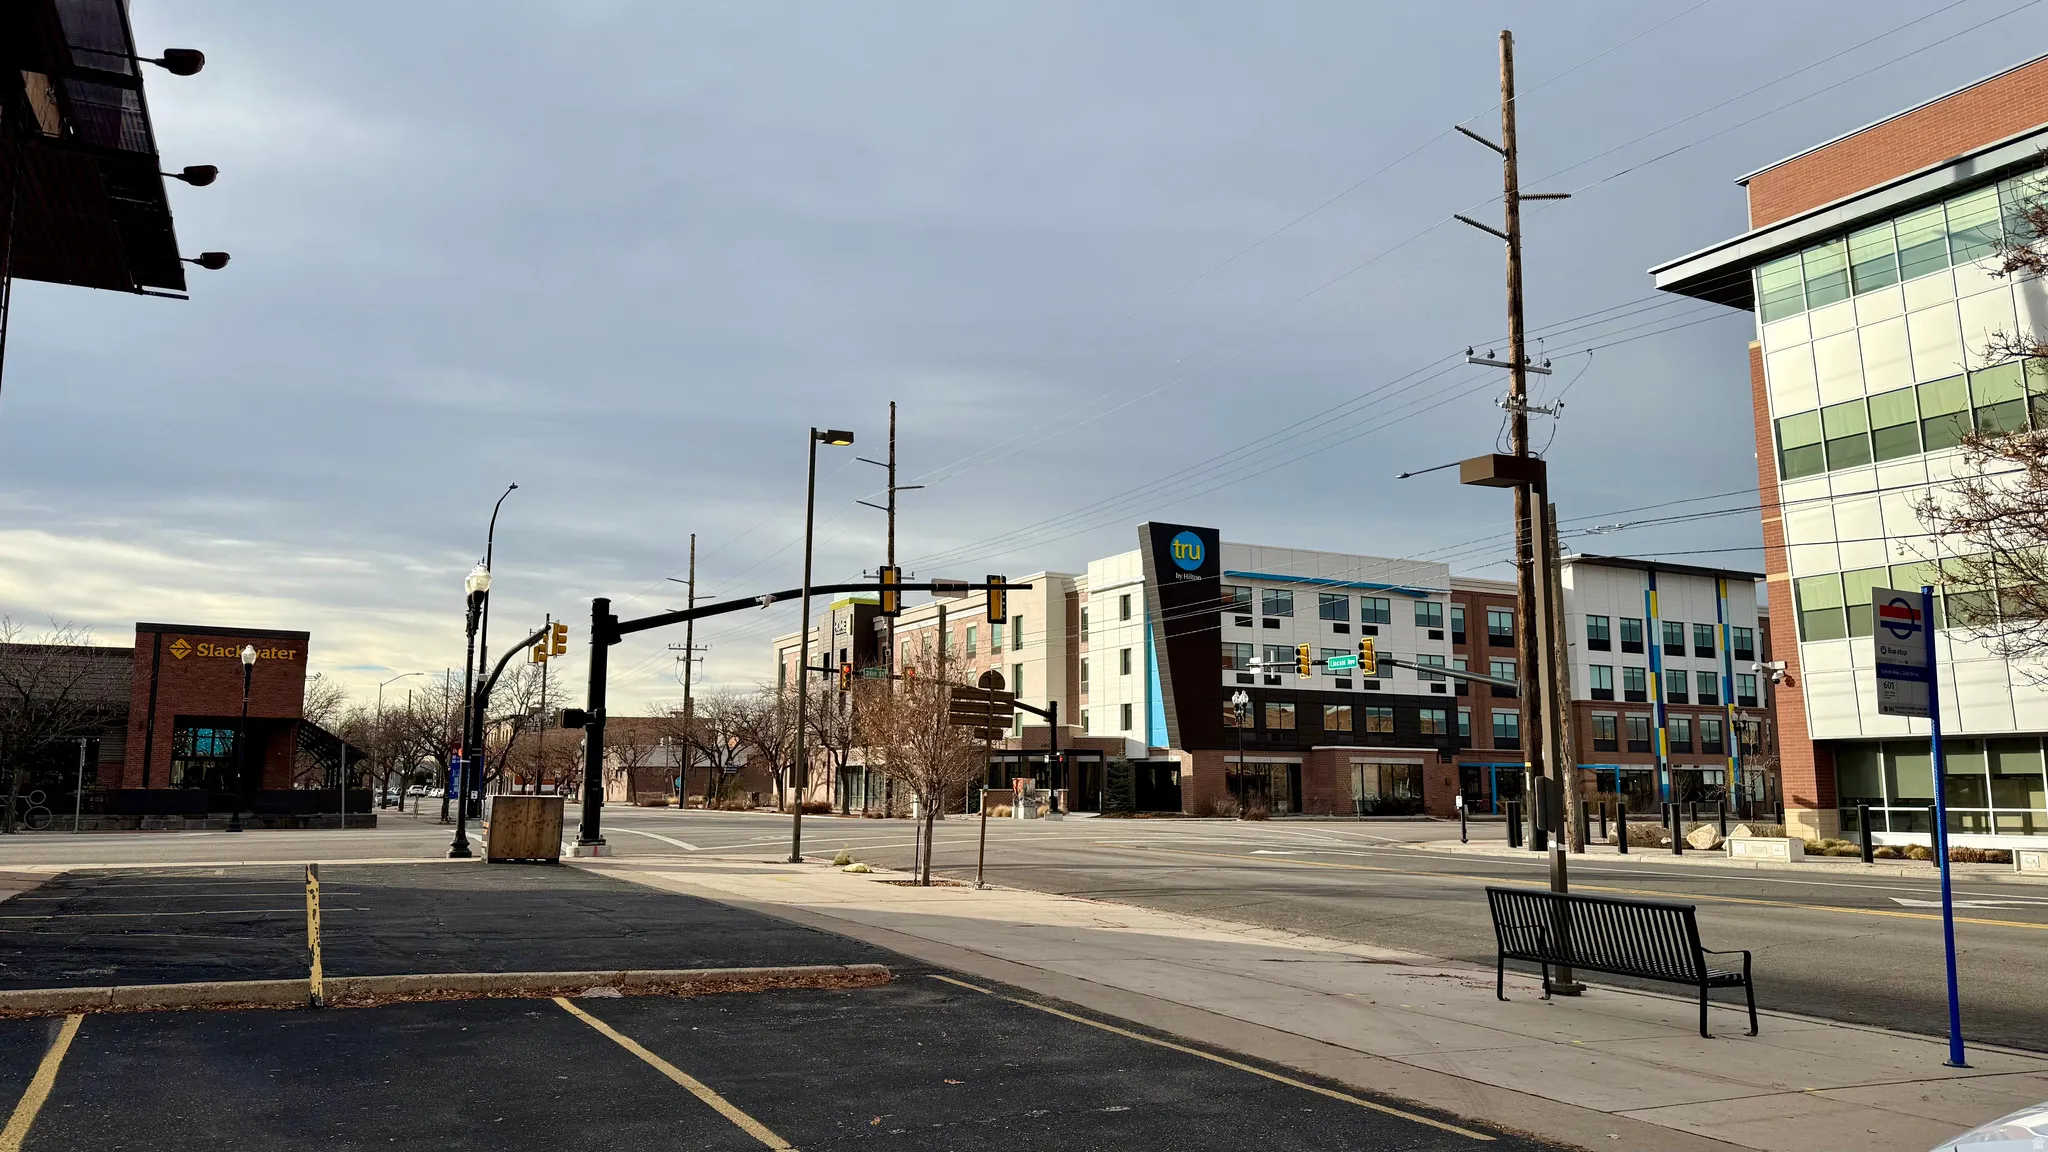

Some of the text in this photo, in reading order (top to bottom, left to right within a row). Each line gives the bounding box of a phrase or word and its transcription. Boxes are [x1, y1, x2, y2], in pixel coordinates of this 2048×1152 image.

[1172, 539, 1201, 560] tru
[1175, 572, 1202, 581] by Hilton
[197, 643, 296, 660] Slackater
[1887, 647, 1908, 656] Bus stop
[1883, 681, 1895, 690] 601
